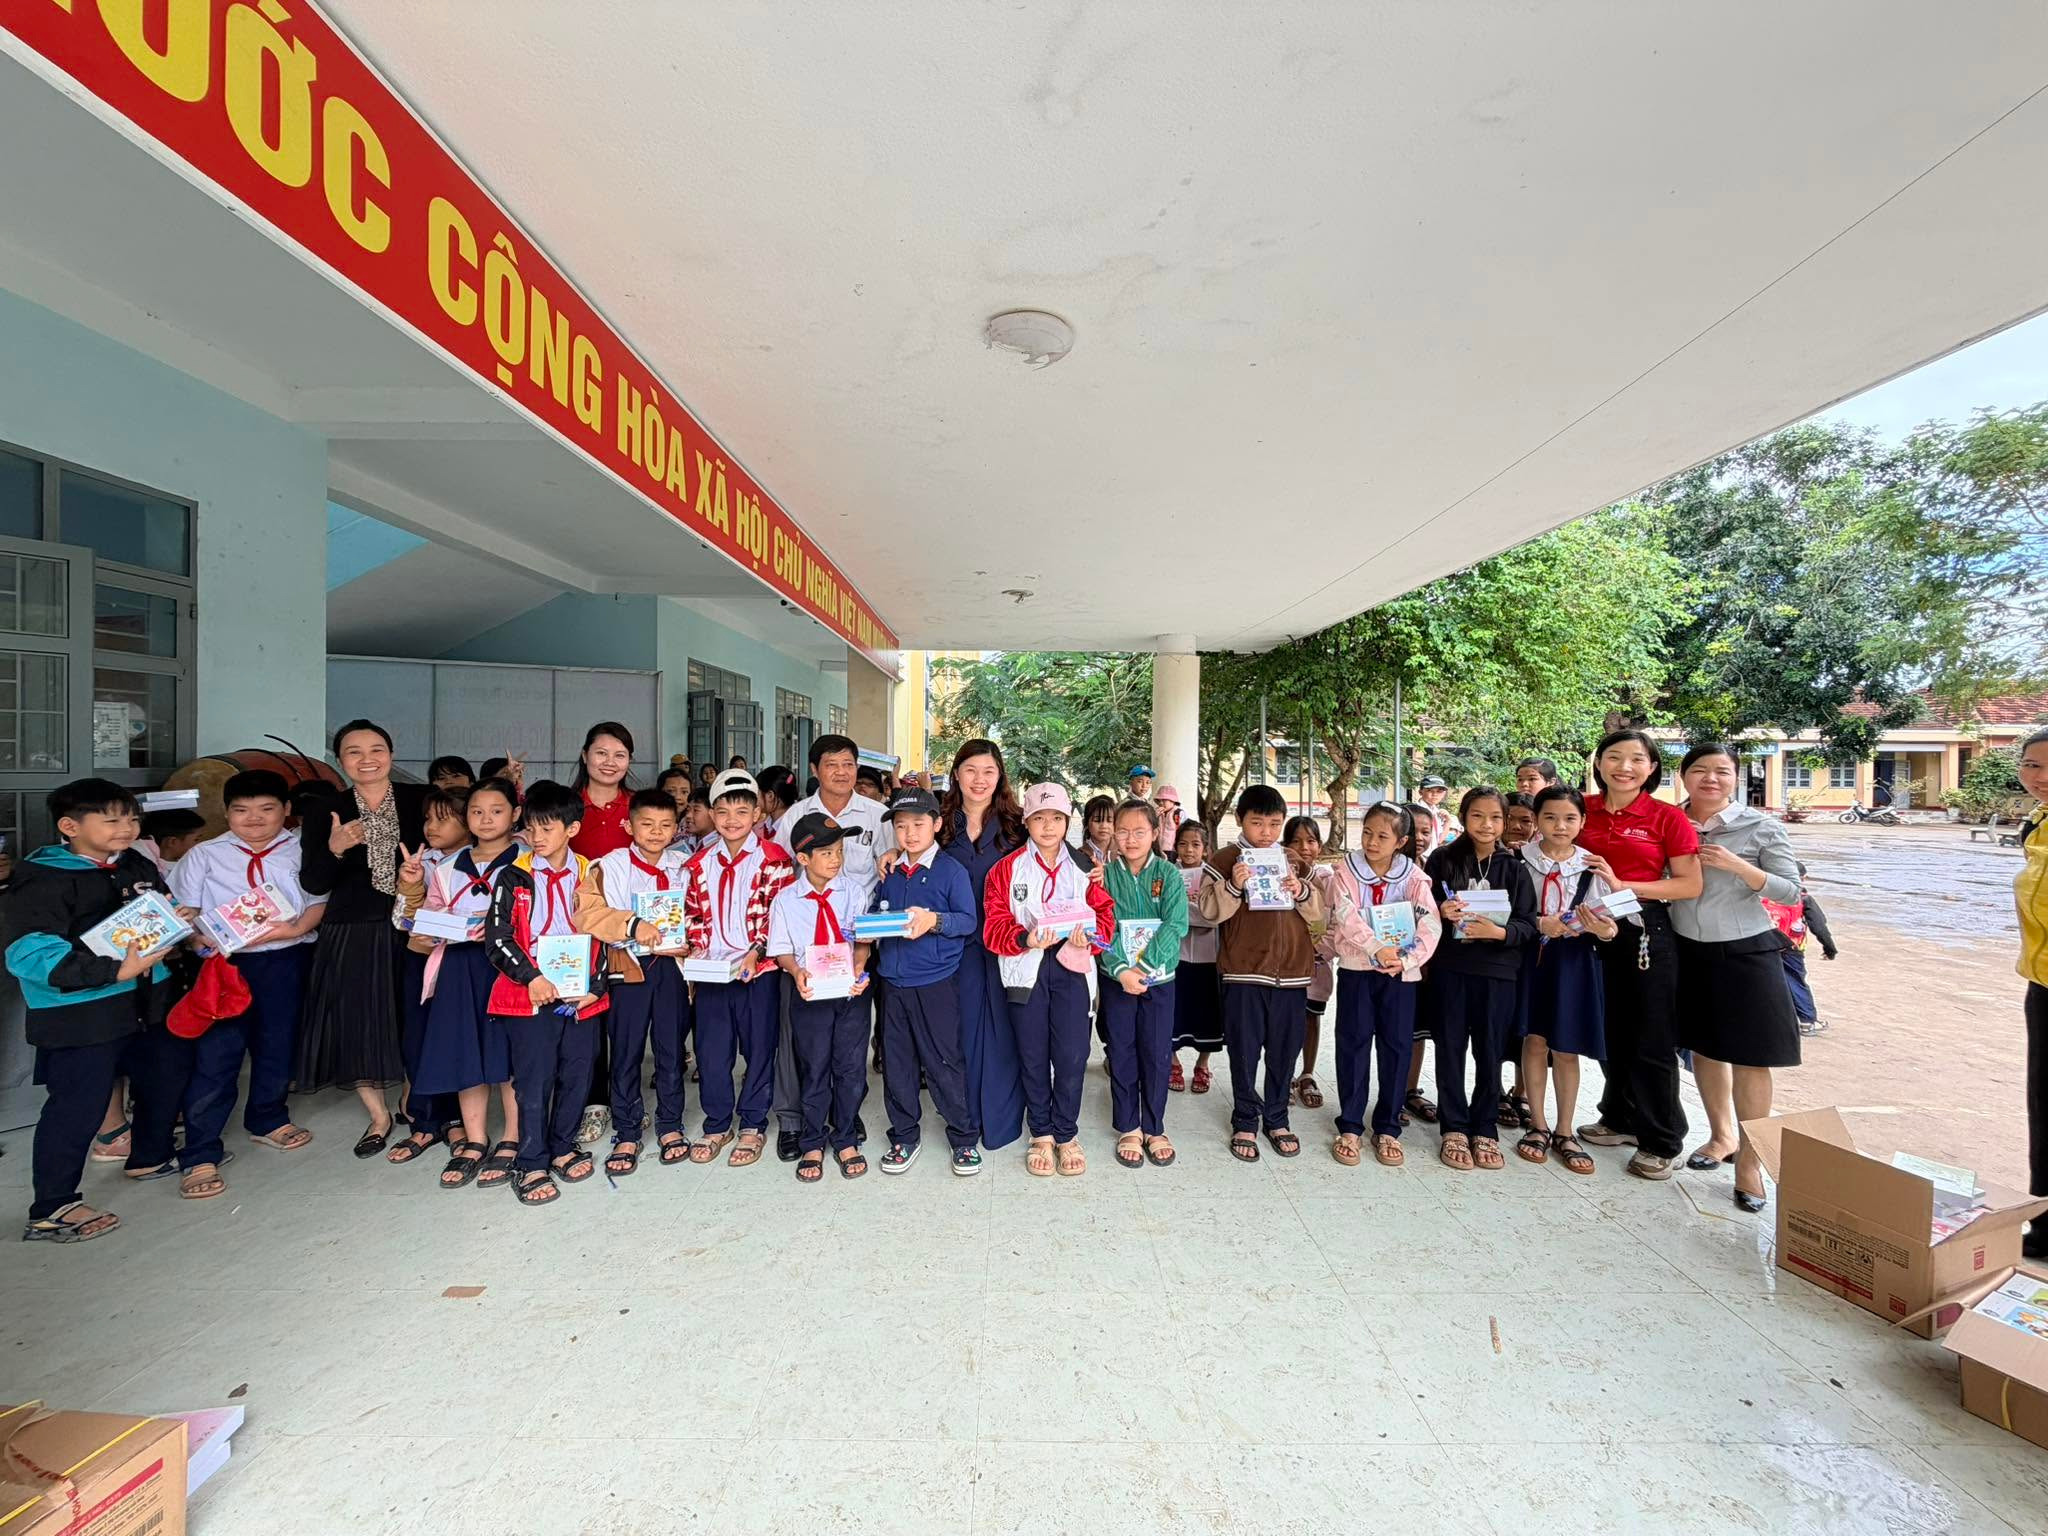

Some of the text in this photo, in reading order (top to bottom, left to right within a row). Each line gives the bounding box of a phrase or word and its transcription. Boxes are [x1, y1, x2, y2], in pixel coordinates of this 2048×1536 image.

[50, 0, 391, 253] ỚC
[428, 196, 602, 436] CỘNG
[617, 372, 687, 504] HÒA
[695, 449, 729, 536] XÃ
[735, 488, 768, 571] HỘI
[773, 526, 803, 591] CHỦ
[805, 555, 838, 621] NGHĨA
[840, 589, 856, 640] VIỆT
[857, 607, 872, 649] NAM
